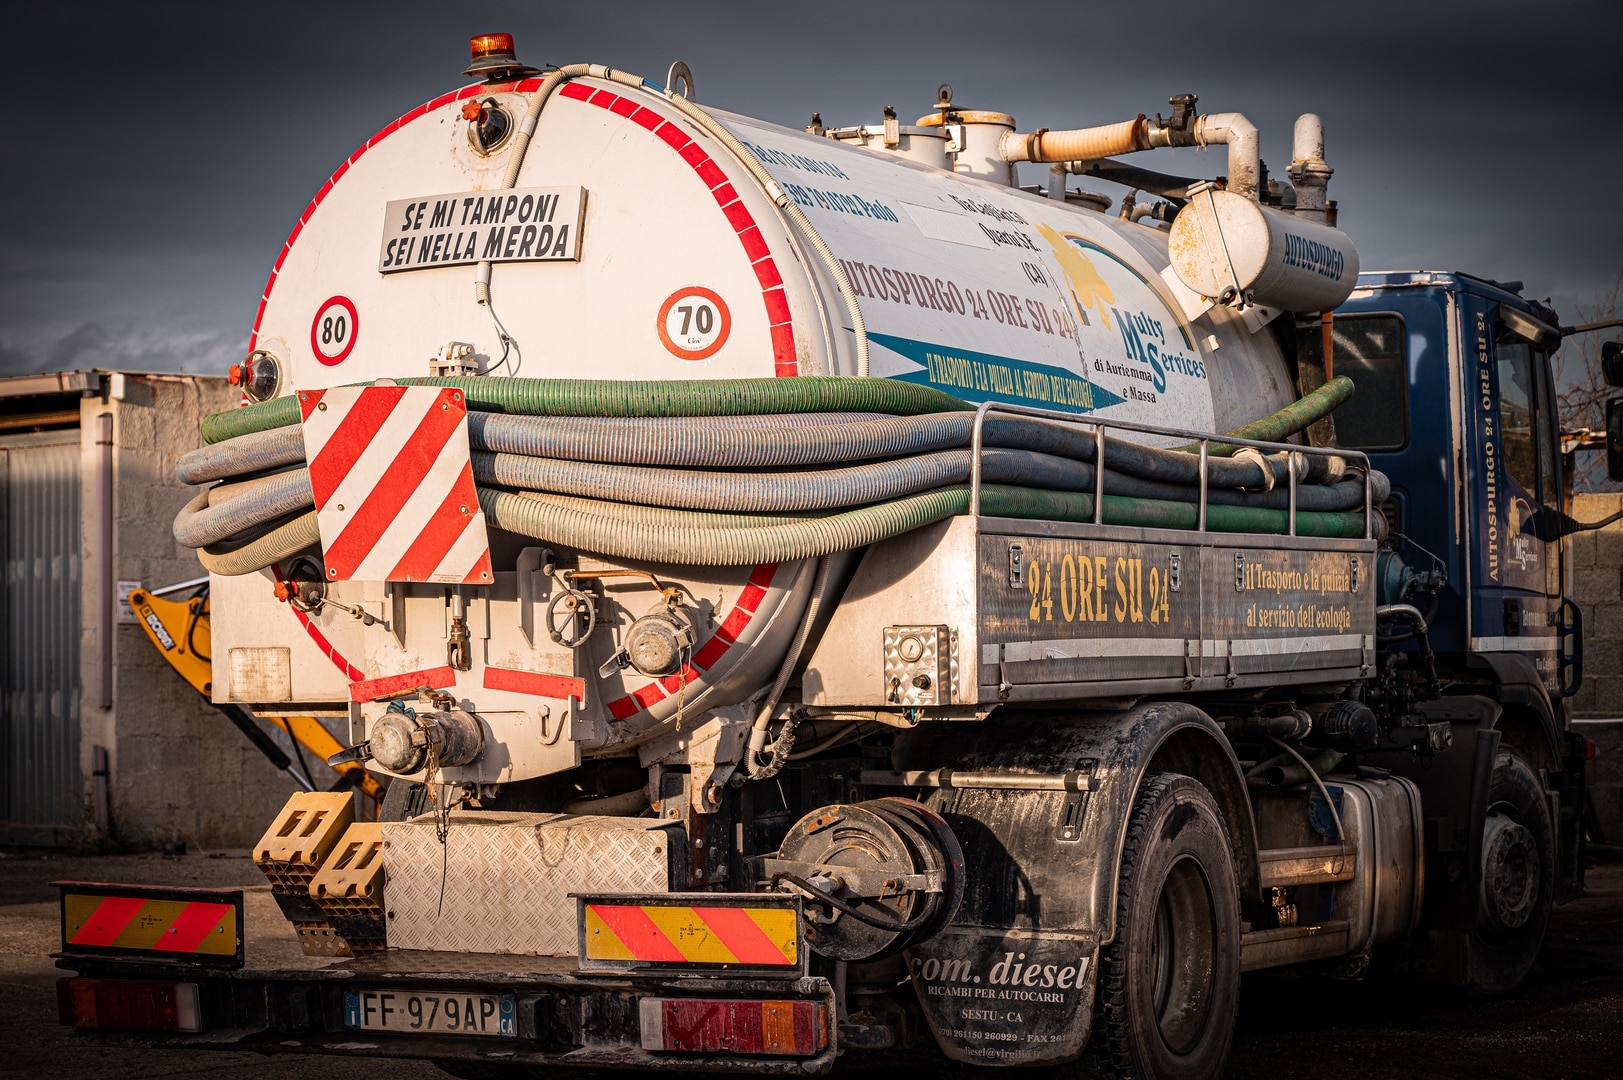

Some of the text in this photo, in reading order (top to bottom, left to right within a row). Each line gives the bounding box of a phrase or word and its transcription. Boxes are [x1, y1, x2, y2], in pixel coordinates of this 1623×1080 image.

[401, 194, 560, 231] SE MI TAMPONI
[782, 182, 899, 223] 329 7910722 Paolo
[383, 224, 569, 267] SEI NELLA MERDA
[1282, 232, 1344, 281] AUTOSPURGO
[1020, 261, 1049, 289] (CA)
[838, 258, 1074, 340] UTOSPURGO 24 ORE SU 24
[322, 315, 346, 344] 80
[678, 304, 713, 335] 70
[1111, 307, 1165, 363] Multy
[926, 353, 936, 383] IL
[933, 353, 973, 389] TRASPORTO
[987, 363, 1015, 396] PULIZIA
[1014, 368, 1024, 397] AL
[1022, 370, 1051, 402] SERVIZIO
[1094, 359, 1153, 383] di Auriemma
[1147, 342, 1207, 394] Services
[1123, 386, 1157, 404] e Massa
[1476, 311, 1500, 582] AUTOSPURGO 24 ORE SU 24
[1028, 553, 1170, 625] 24 ORE SU 24
[1246, 563, 1350, 596] il Trasporto e la pulizia
[1246, 602, 1351, 634] al servizio dell'ecologia
[911, 951, 1090, 990] com. diesel
[362, 993, 495, 1031] FF 979AP
[928, 985, 1064, 1003] RICAMBI PER AUTOCARRI
[500, 1017, 514, 1034] CA
[961, 1008, 998, 1021] SESTU
[1006, 1011, 1023, 1023] CA
[953, 1028, 983, 1040] 261150
[984, 1030, 1018, 1042] 260929
[1026, 1034, 1049, 1044] FAX
